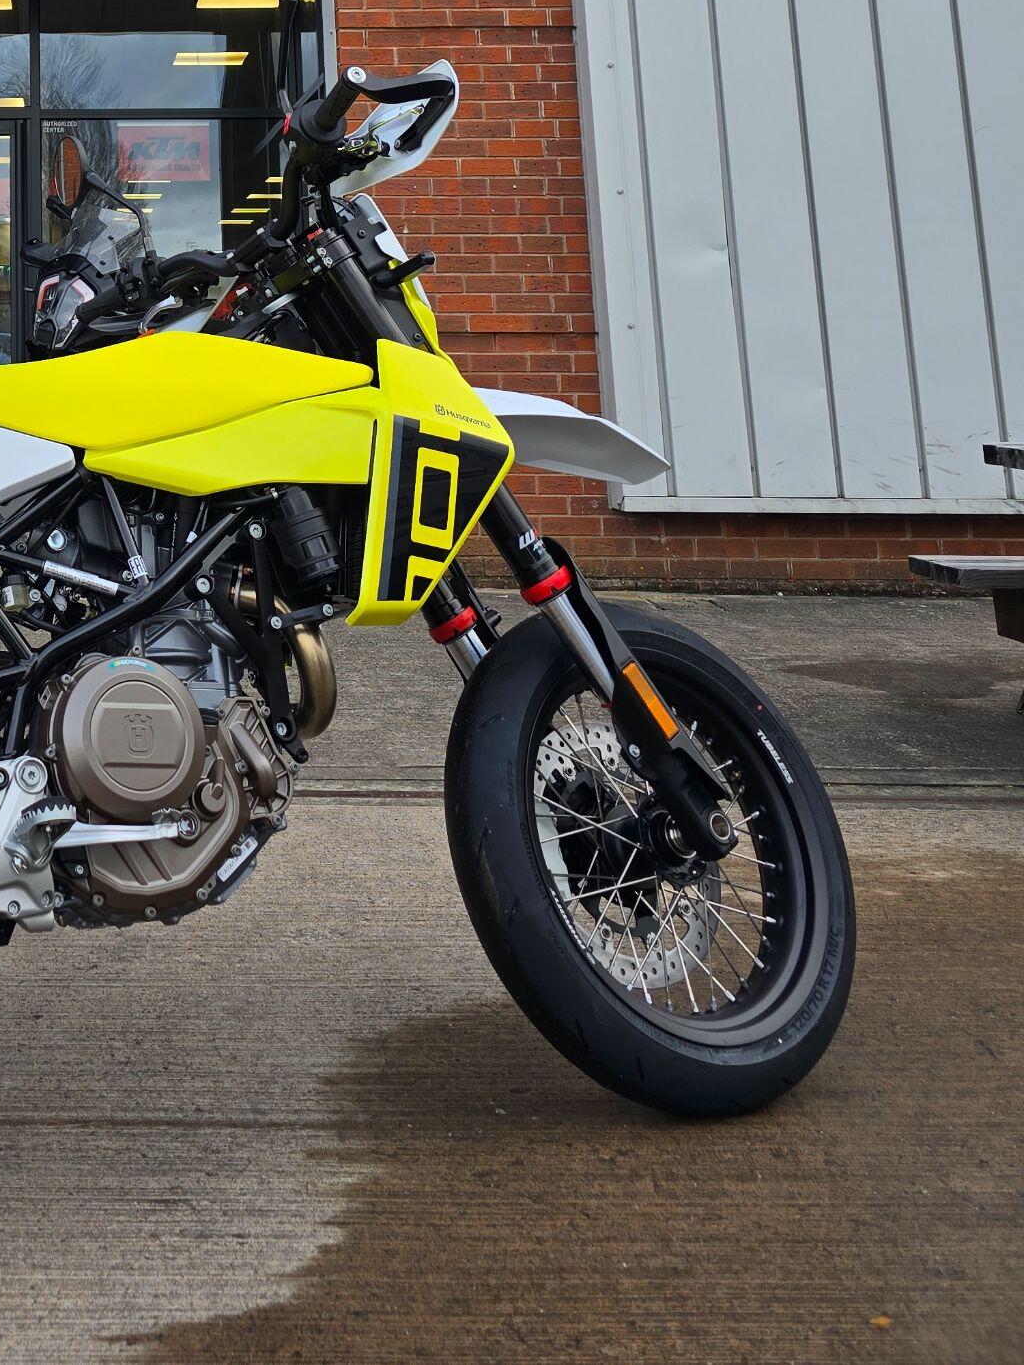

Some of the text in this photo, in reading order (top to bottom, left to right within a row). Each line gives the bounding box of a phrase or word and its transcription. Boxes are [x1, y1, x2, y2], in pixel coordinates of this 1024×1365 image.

[42, 120, 78, 128] AUTHORIZED
[128, 136, 202, 161] KTM
[445, 408, 491, 429] Husqvarna
[757, 728, 794, 784] TUBELESS
